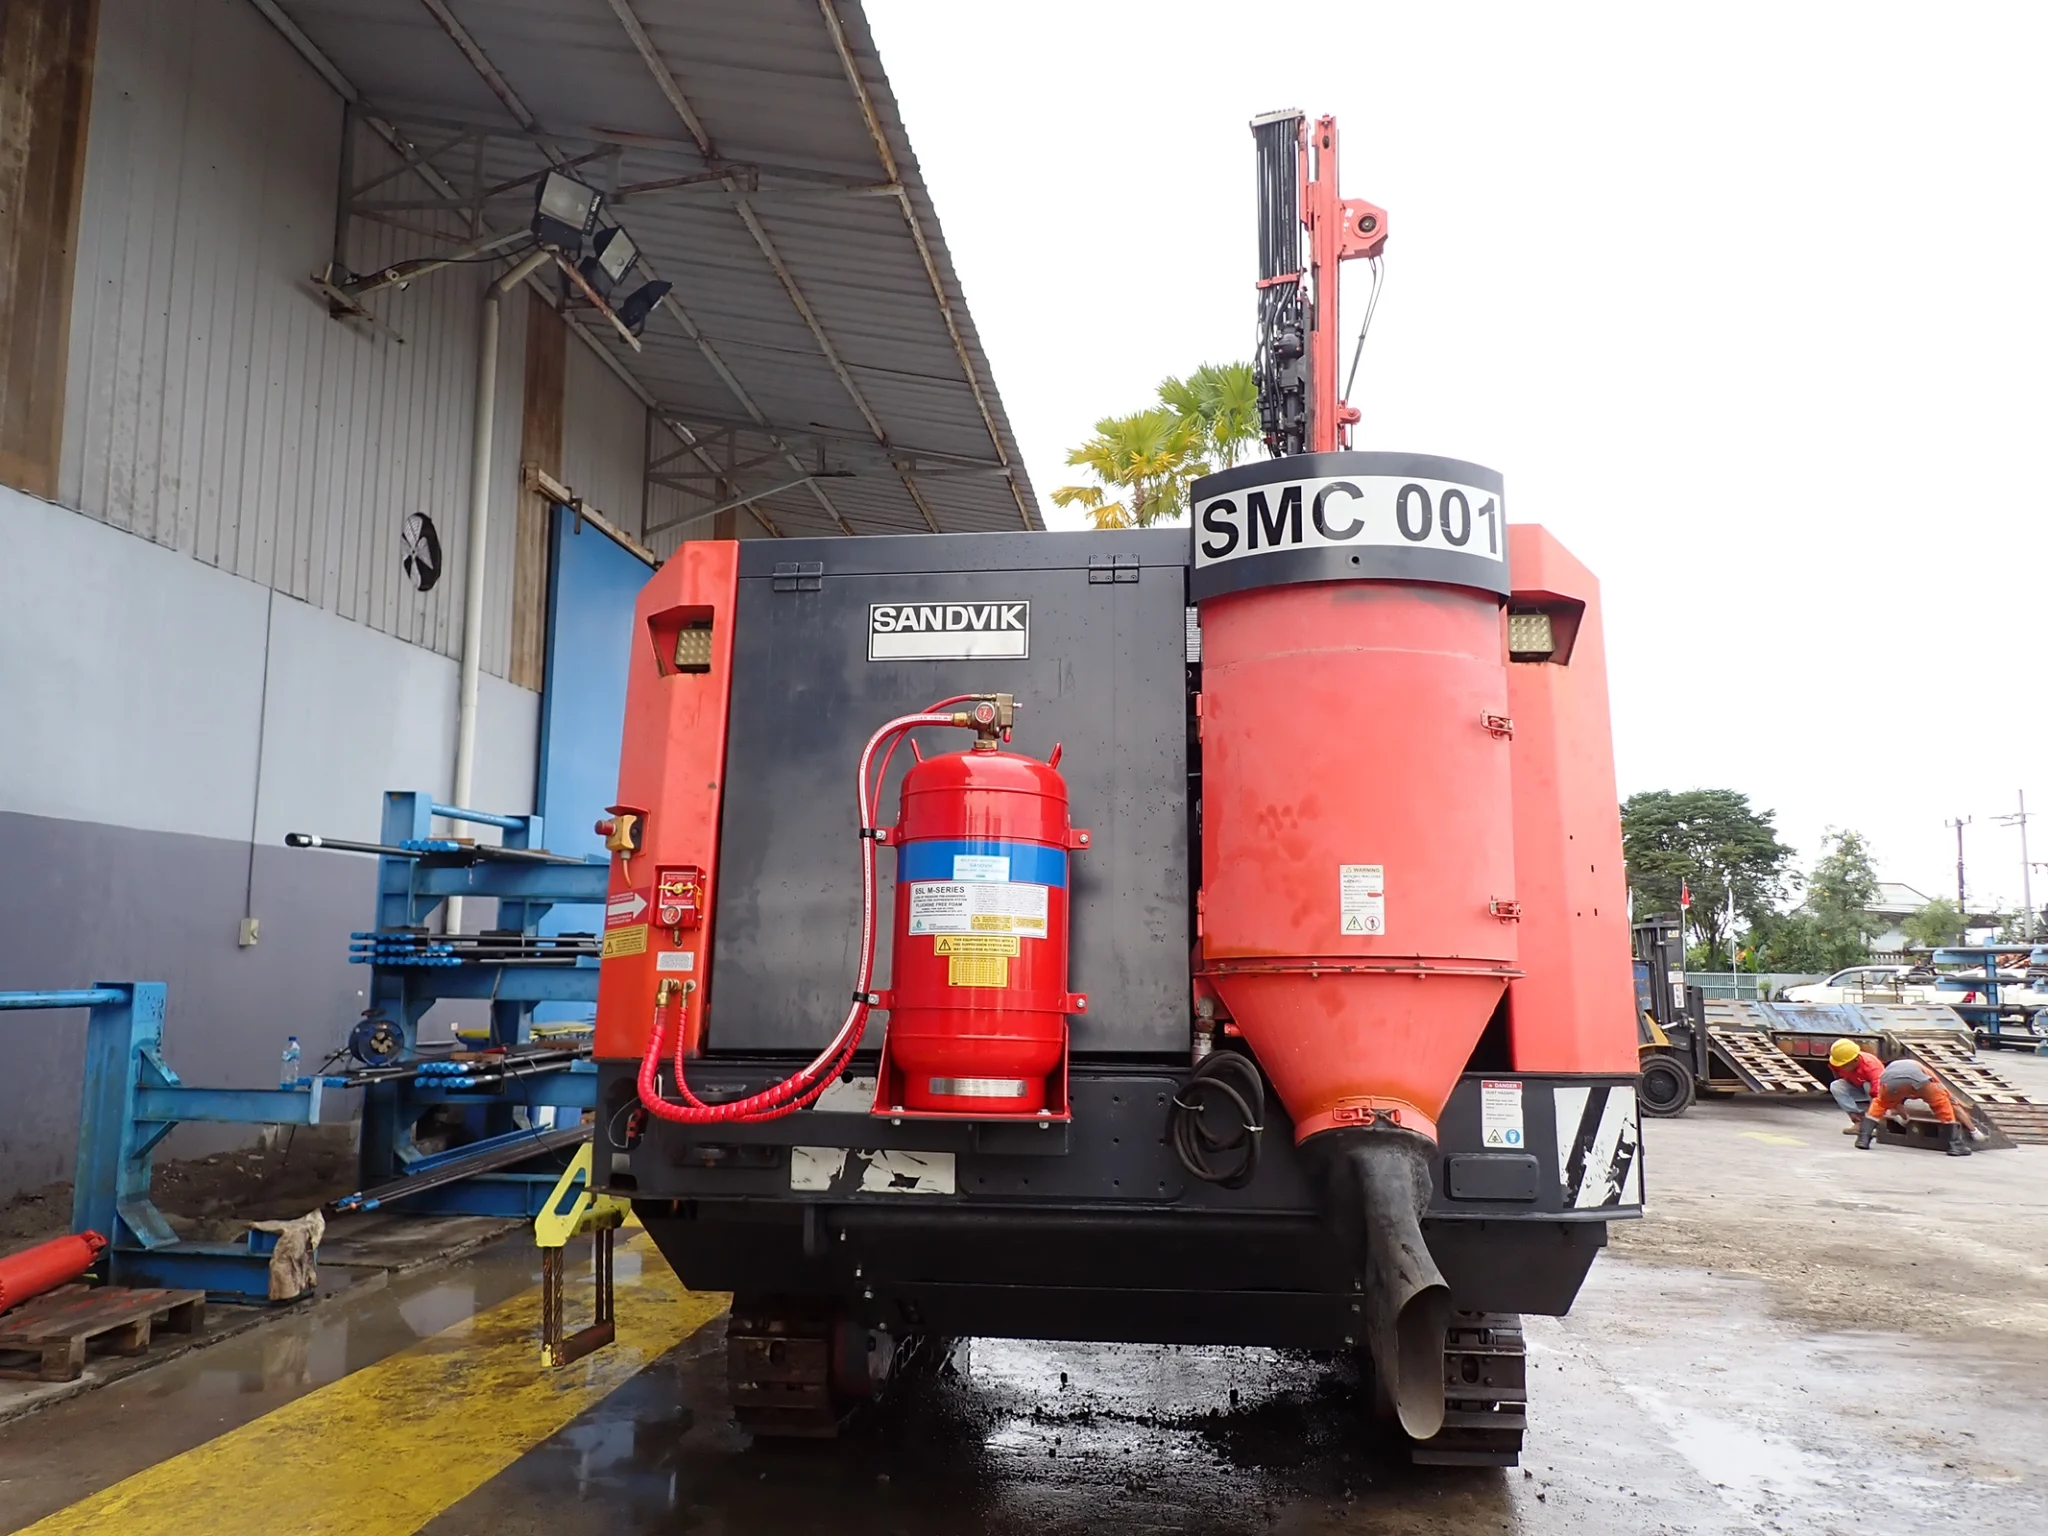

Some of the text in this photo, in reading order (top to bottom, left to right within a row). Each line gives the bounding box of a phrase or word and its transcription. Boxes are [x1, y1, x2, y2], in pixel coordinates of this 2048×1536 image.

[1201, 482, 1498, 559] SMC 001
[873, 605, 1025, 632] SANDVIK
[927, 886, 965, 894] M-SERIES
